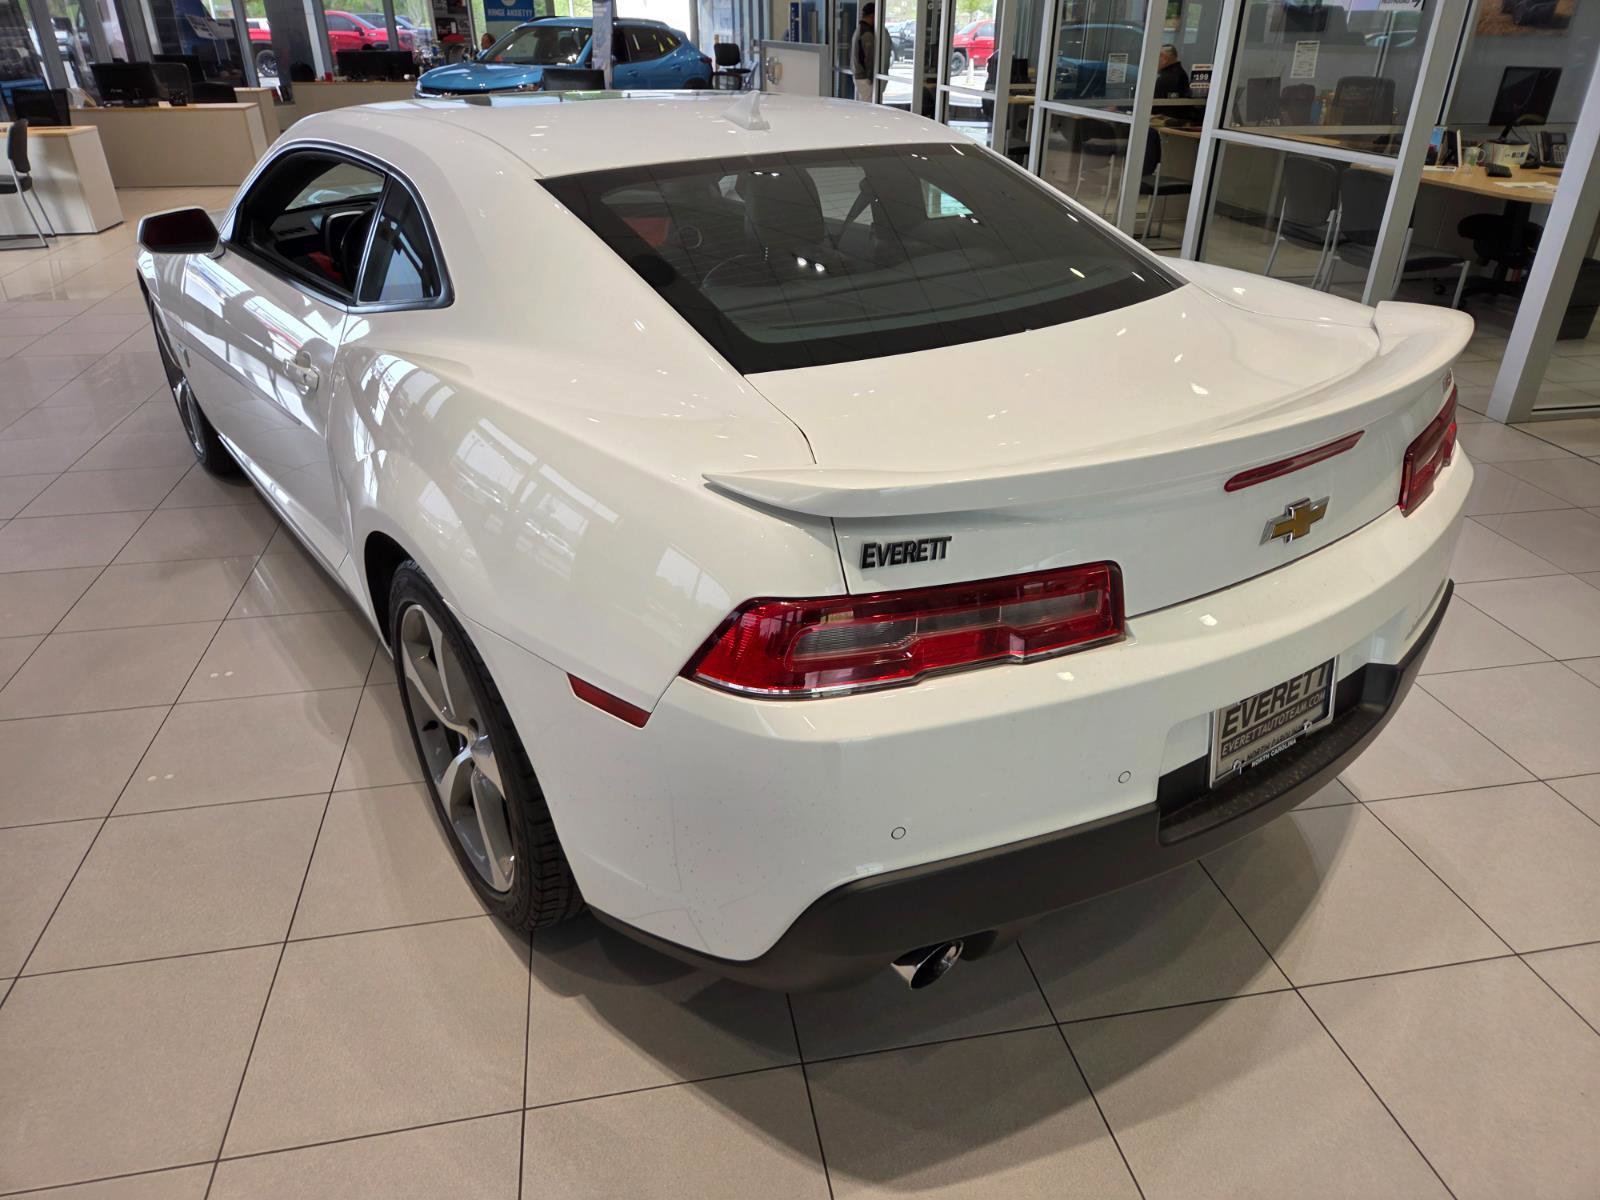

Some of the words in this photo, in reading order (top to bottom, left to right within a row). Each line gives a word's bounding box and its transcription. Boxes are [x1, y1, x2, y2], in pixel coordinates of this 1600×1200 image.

[860, 535, 952, 569] EVERETT
[1223, 664, 1328, 739] EVERETT
[1251, 753, 1270, 768] NORTH
[1270, 738, 1297, 757] CAROLINA
